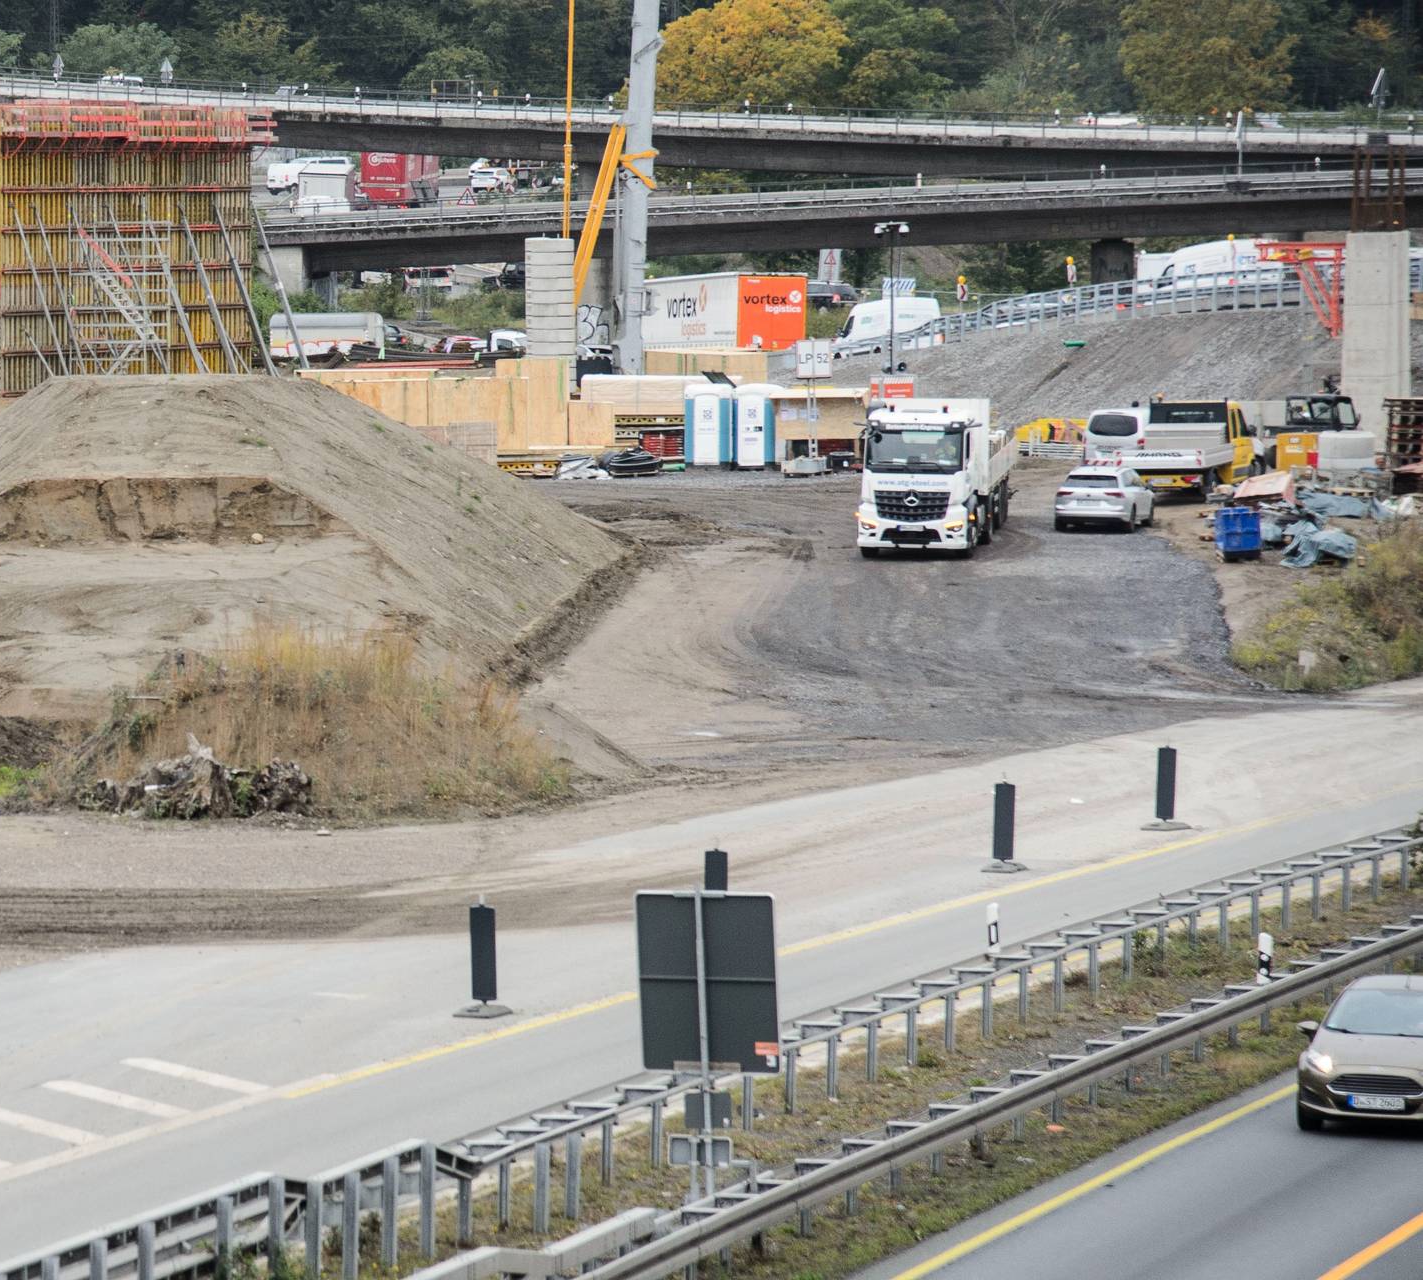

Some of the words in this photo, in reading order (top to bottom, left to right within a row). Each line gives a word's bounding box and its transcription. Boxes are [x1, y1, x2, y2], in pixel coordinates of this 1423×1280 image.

[743, 293, 787, 305] vortex
[667, 293, 697, 318] vortex
[765, 304, 802, 315] logistics
[681, 320, 706, 336] logistics
[799, 354, 813, 364] LP
[817, 353, 828, 364] 52
